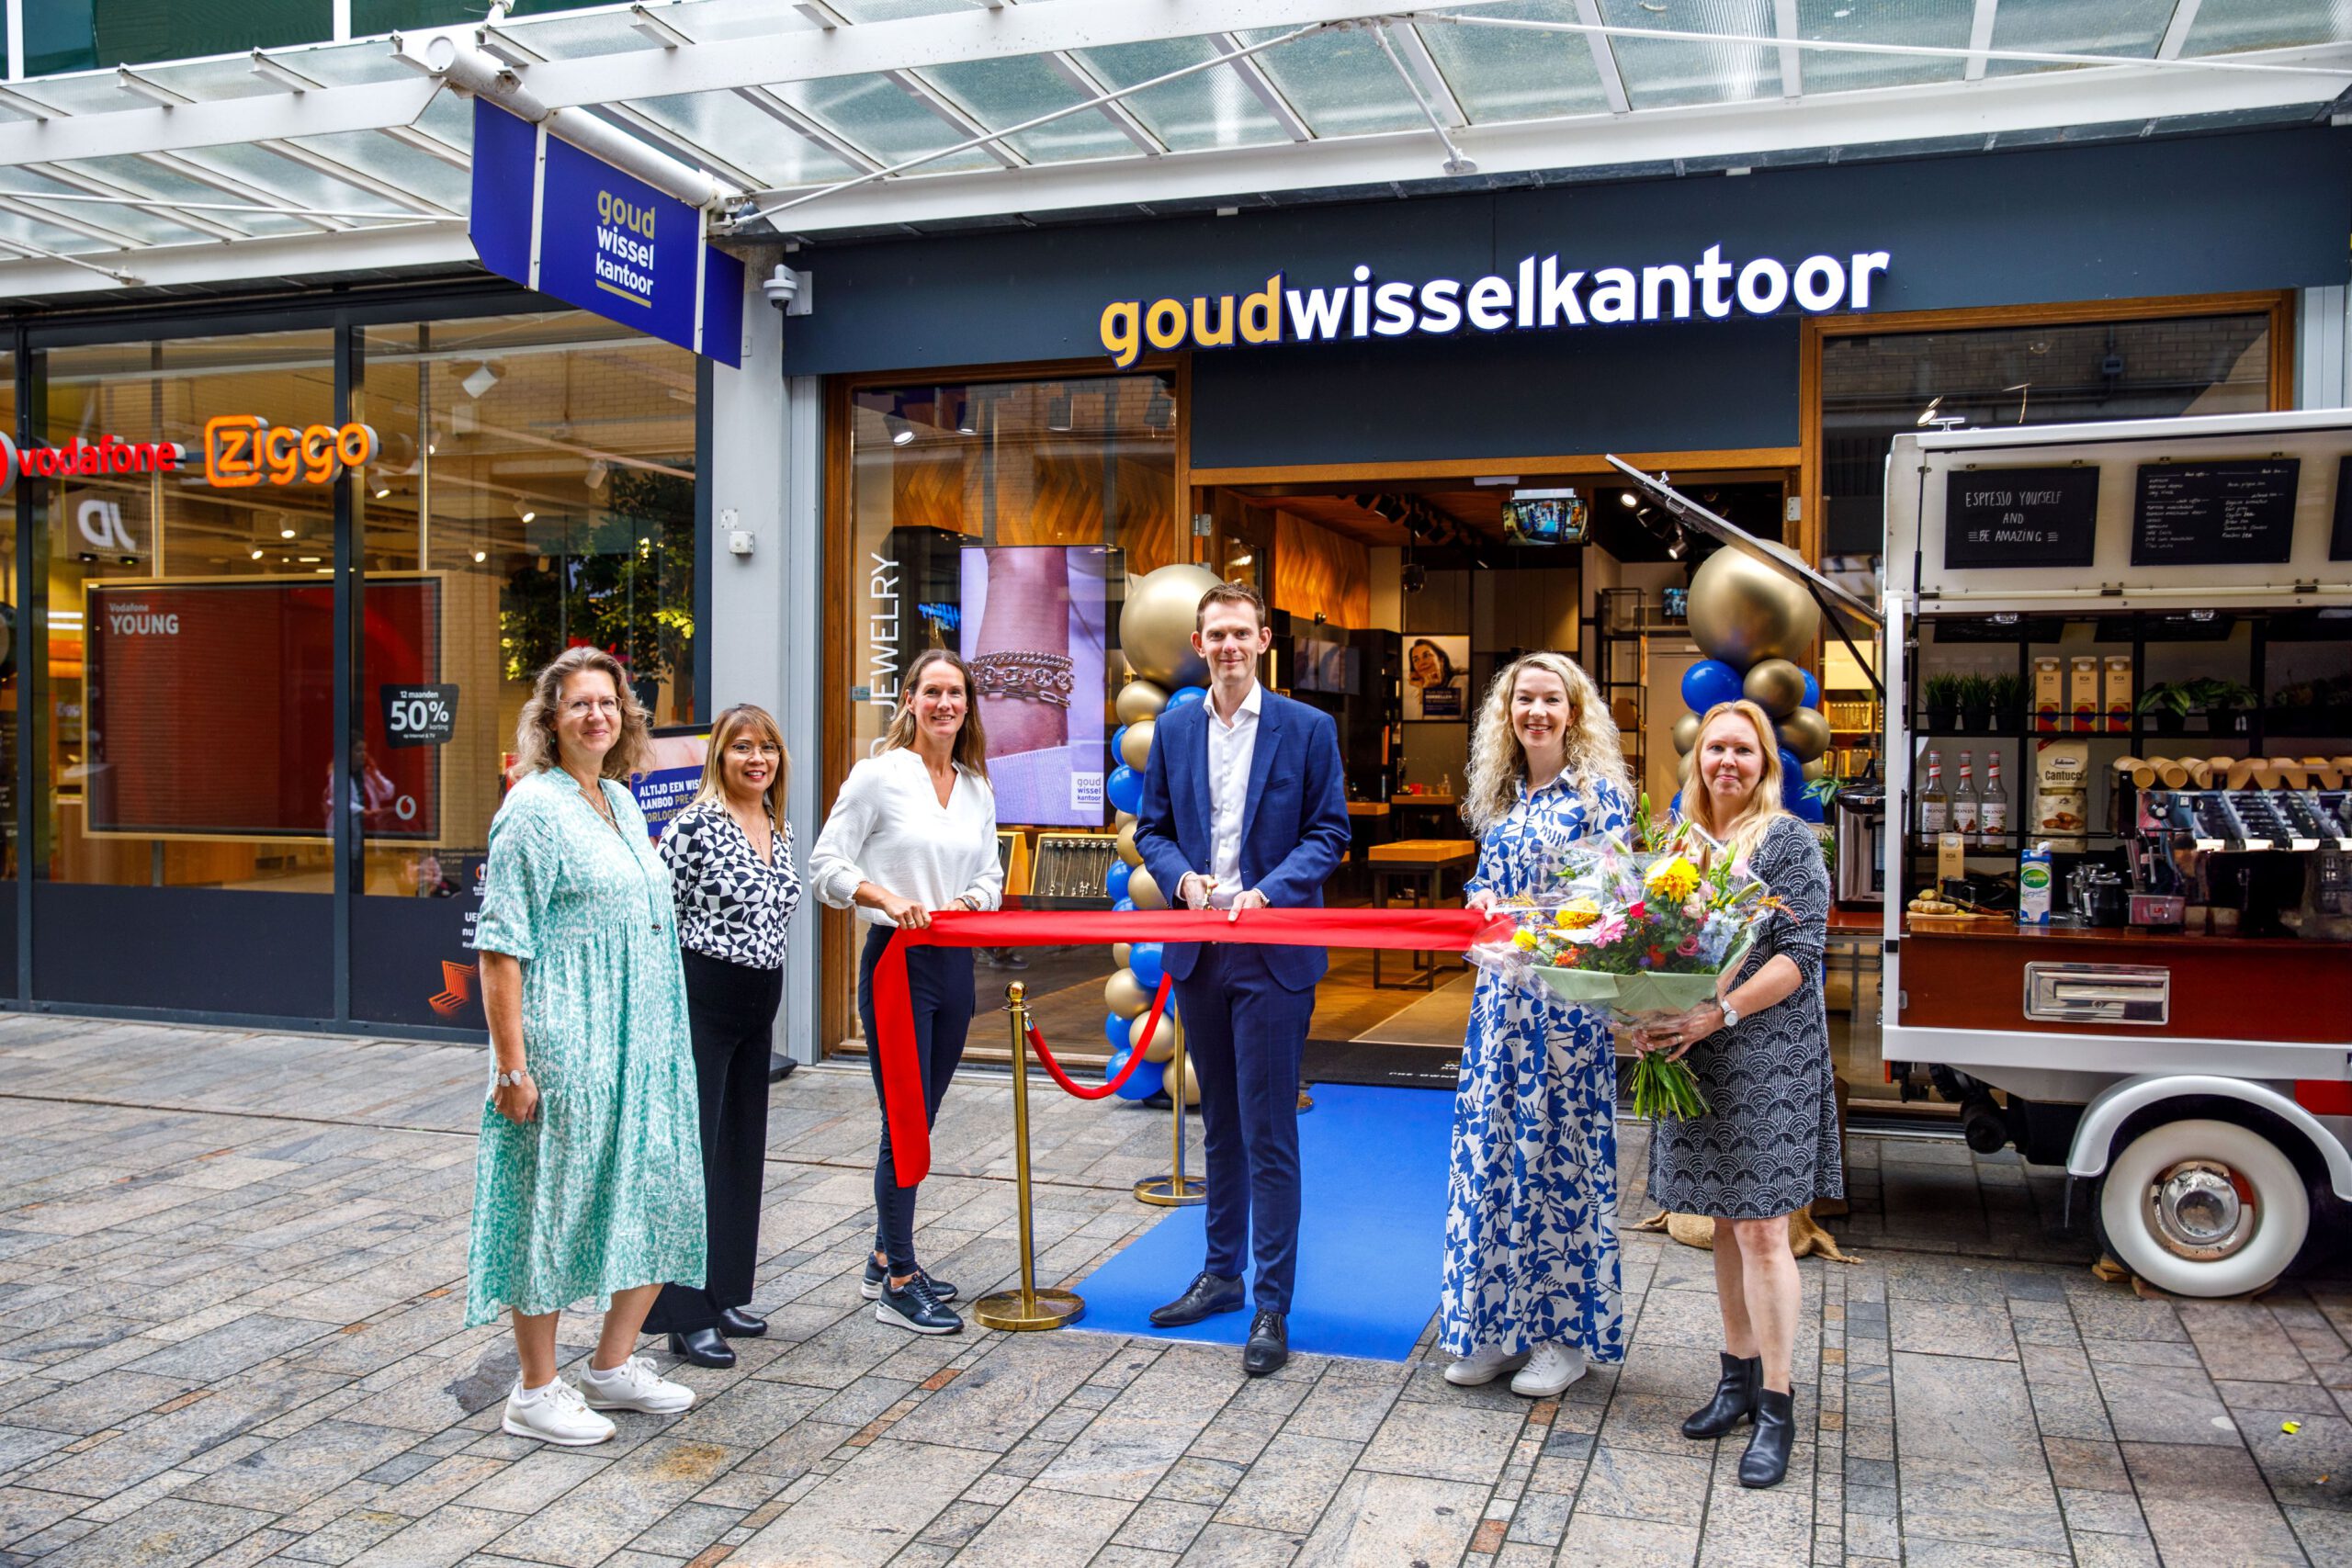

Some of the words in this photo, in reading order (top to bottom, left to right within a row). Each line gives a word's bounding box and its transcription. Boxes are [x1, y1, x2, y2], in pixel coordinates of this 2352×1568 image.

[597, 190, 655, 240] goud
[597, 225, 654, 270] wissel
[596, 252, 653, 296] kantoor
[1100, 243, 1891, 369] goudwisselkantoor
[17, 434, 176, 477] vodafone
[2003, 513, 2024, 525] AND
[1979, 530, 1991, 542] BE
[109, 603, 150, 613] Vodafone
[110, 614, 179, 635] YOUNG
[870, 552, 899, 722] JEWELRY
[390, 700, 449, 731] 50%
[639, 783, 668, 797] ALTIJD
[669, 781, 684, 793] EEN
[685, 779, 701, 790] WIS
[1077, 777, 1102, 787] goud
[640, 796, 673, 810] AANBOD
